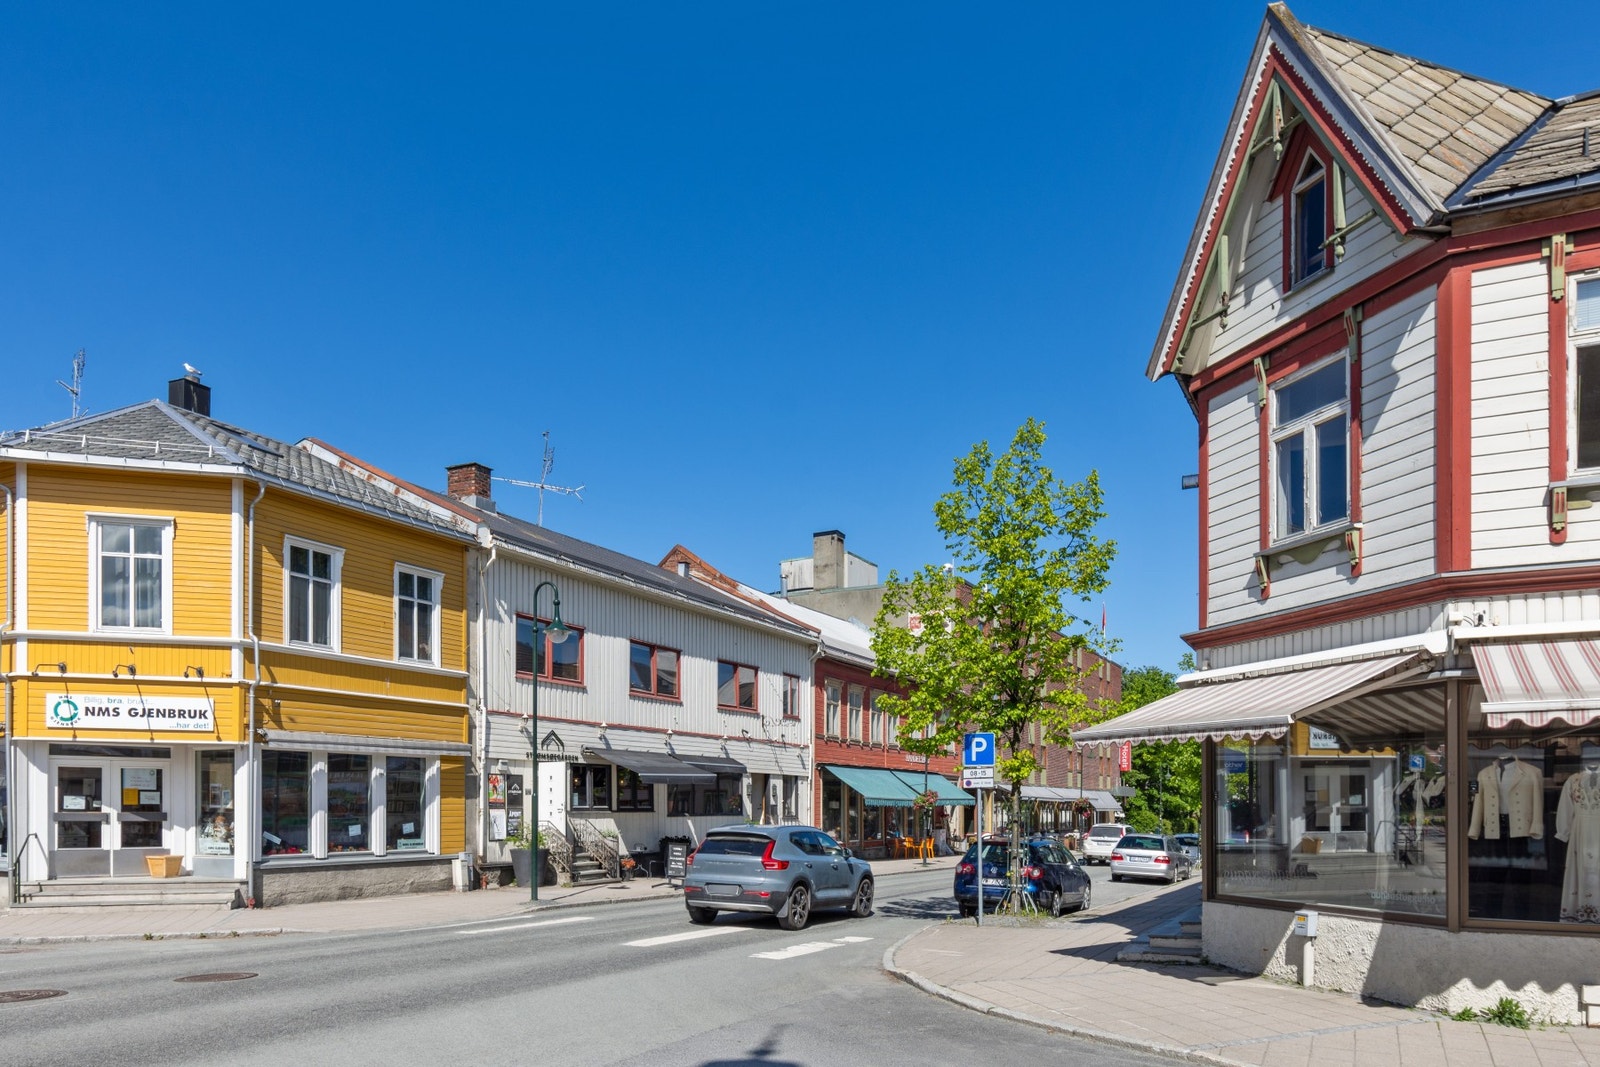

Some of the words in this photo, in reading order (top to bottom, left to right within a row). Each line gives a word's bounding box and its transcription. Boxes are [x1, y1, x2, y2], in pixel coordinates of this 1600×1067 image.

[84, 706, 120, 717] NMS
[127, 707, 209, 720] GJENBRUK
[971, 737, 988, 762] P
